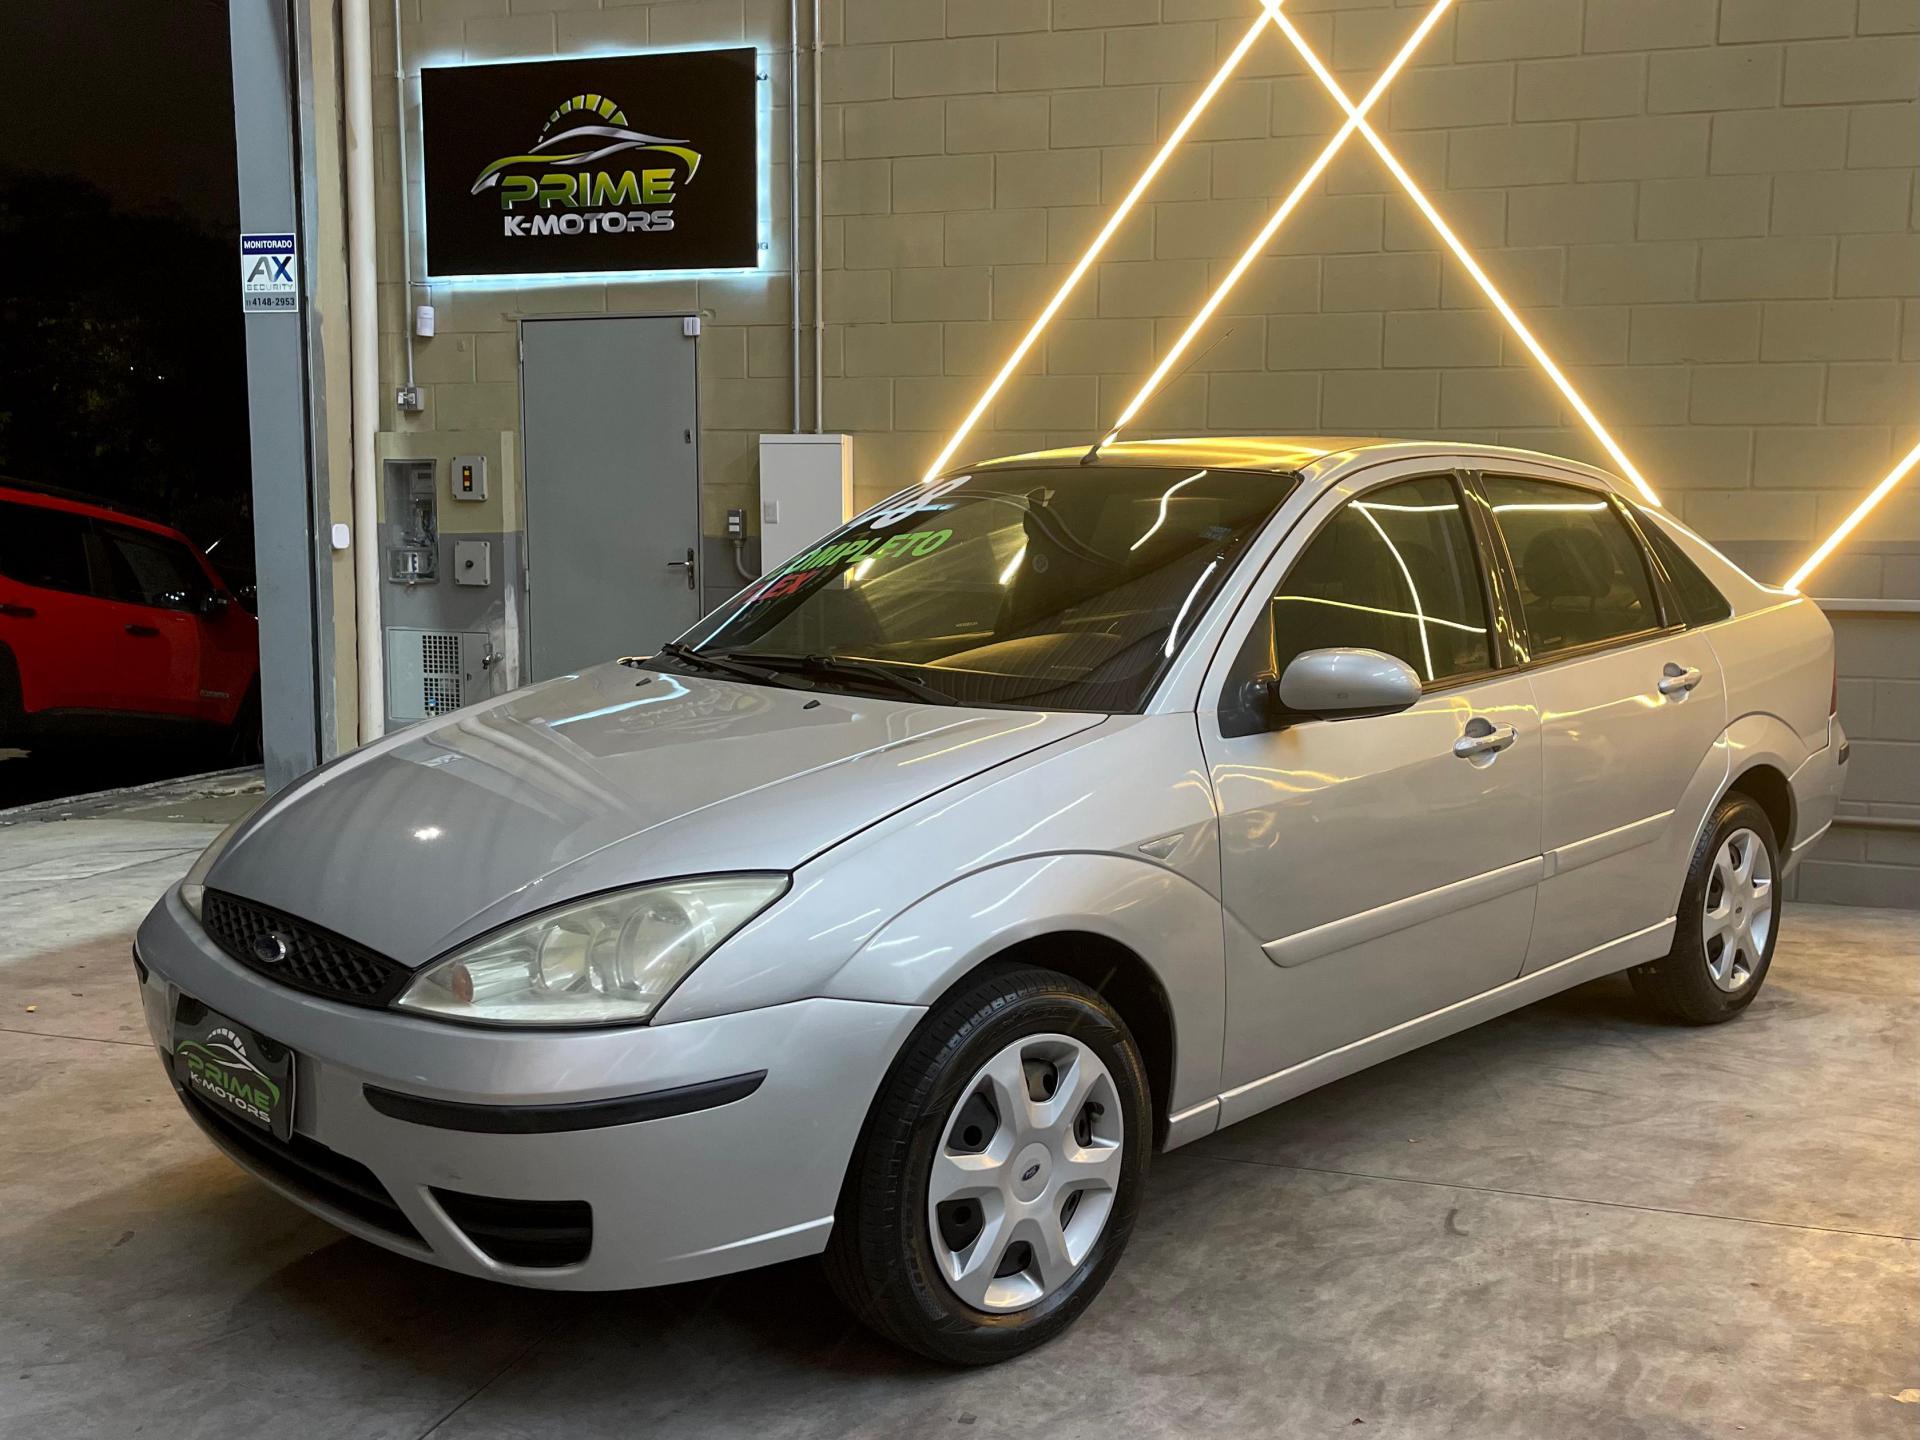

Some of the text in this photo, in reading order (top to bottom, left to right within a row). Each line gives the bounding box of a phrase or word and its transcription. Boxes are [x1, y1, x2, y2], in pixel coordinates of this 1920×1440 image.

[501, 168, 677, 209] PRIME
[503, 210, 675, 237] K-MOTORS
[243, 240, 292, 249] MONITORADO
[247, 256, 293, 282] AX
[246, 283, 293, 291] SECURITY
[253, 297, 295, 306] 4148-2953
[187, 1054, 271, 1113] PRIME
[190, 1071, 271, 1123] K-MOTORS
